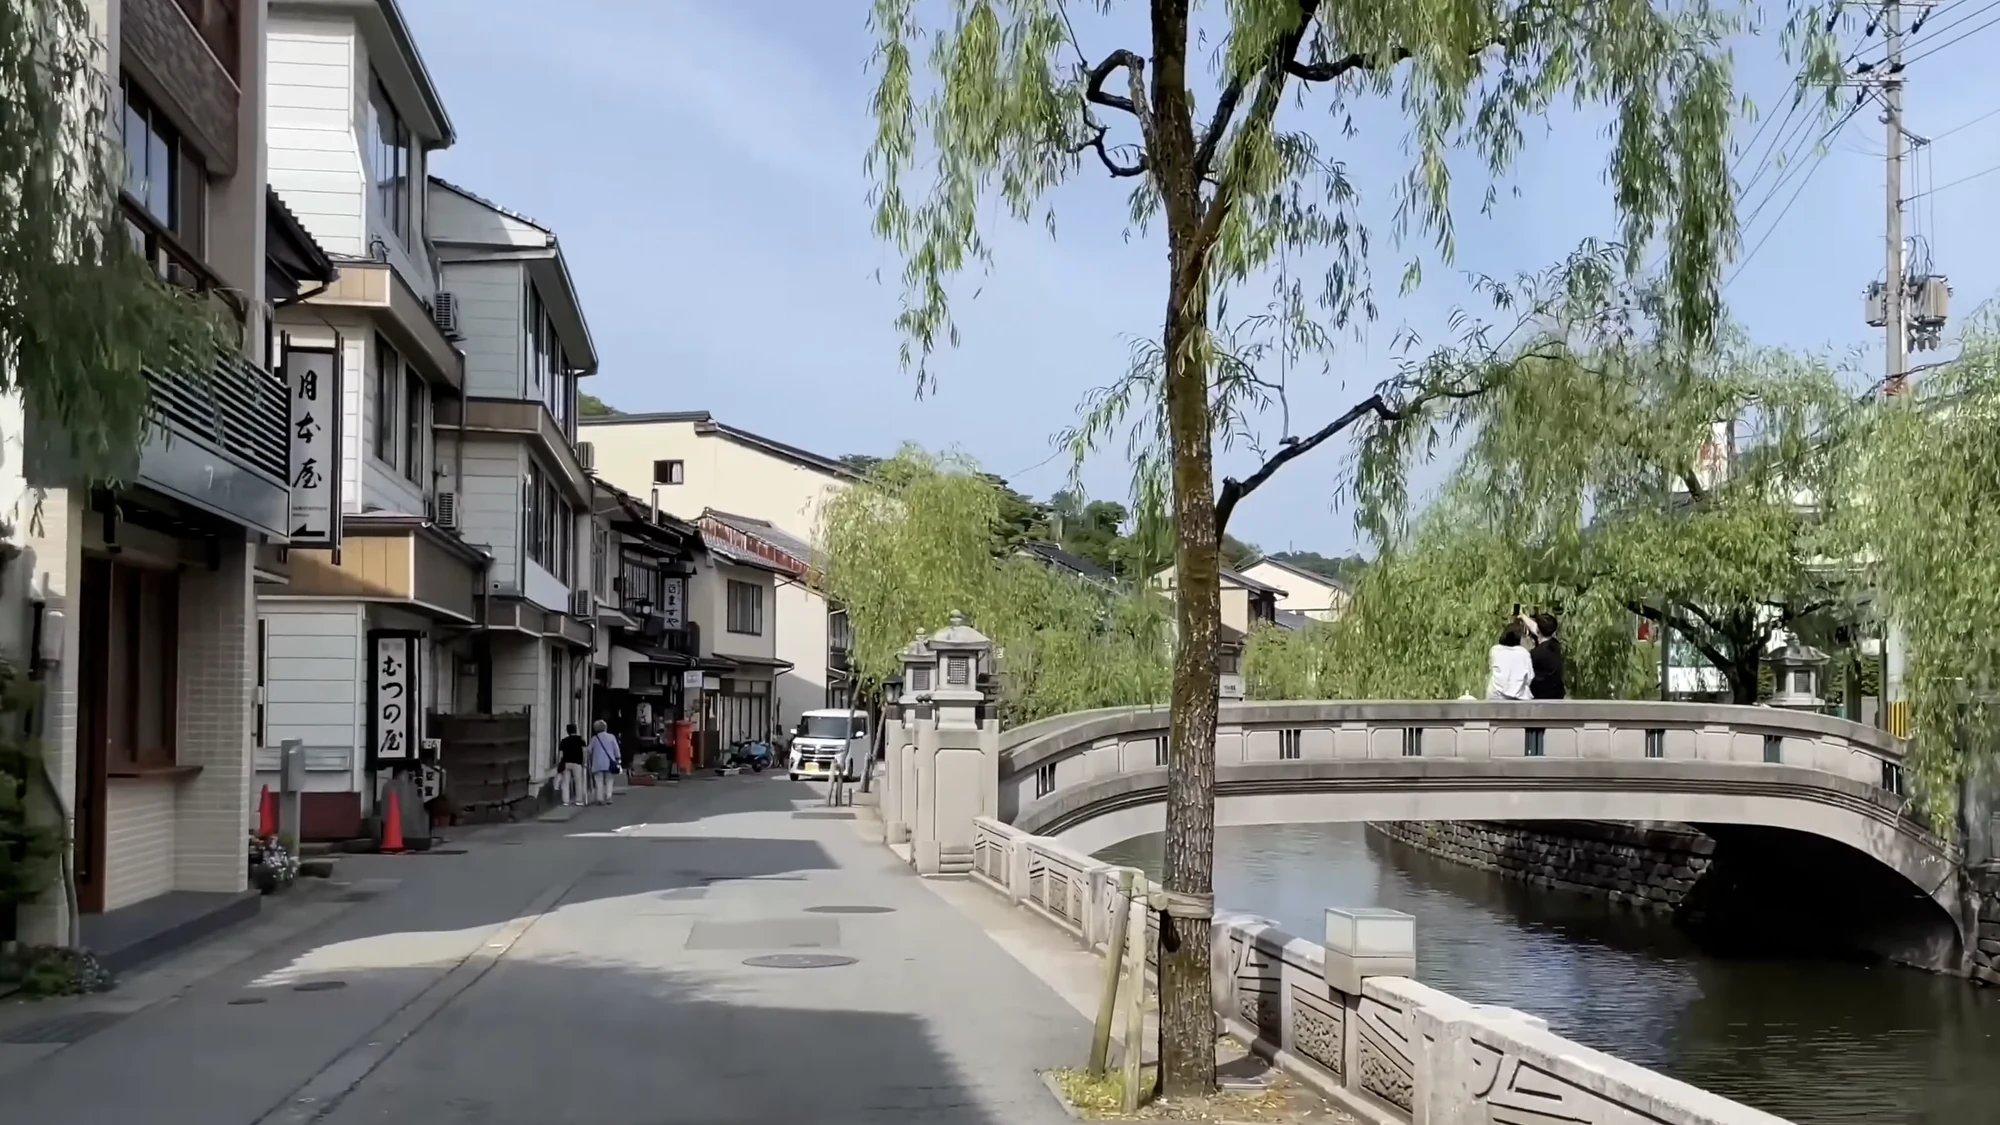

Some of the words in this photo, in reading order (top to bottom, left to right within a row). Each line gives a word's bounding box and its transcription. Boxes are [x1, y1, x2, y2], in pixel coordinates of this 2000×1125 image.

[292, 369, 322, 489] 月本屋
[380, 655, 403, 753] むつの屋
